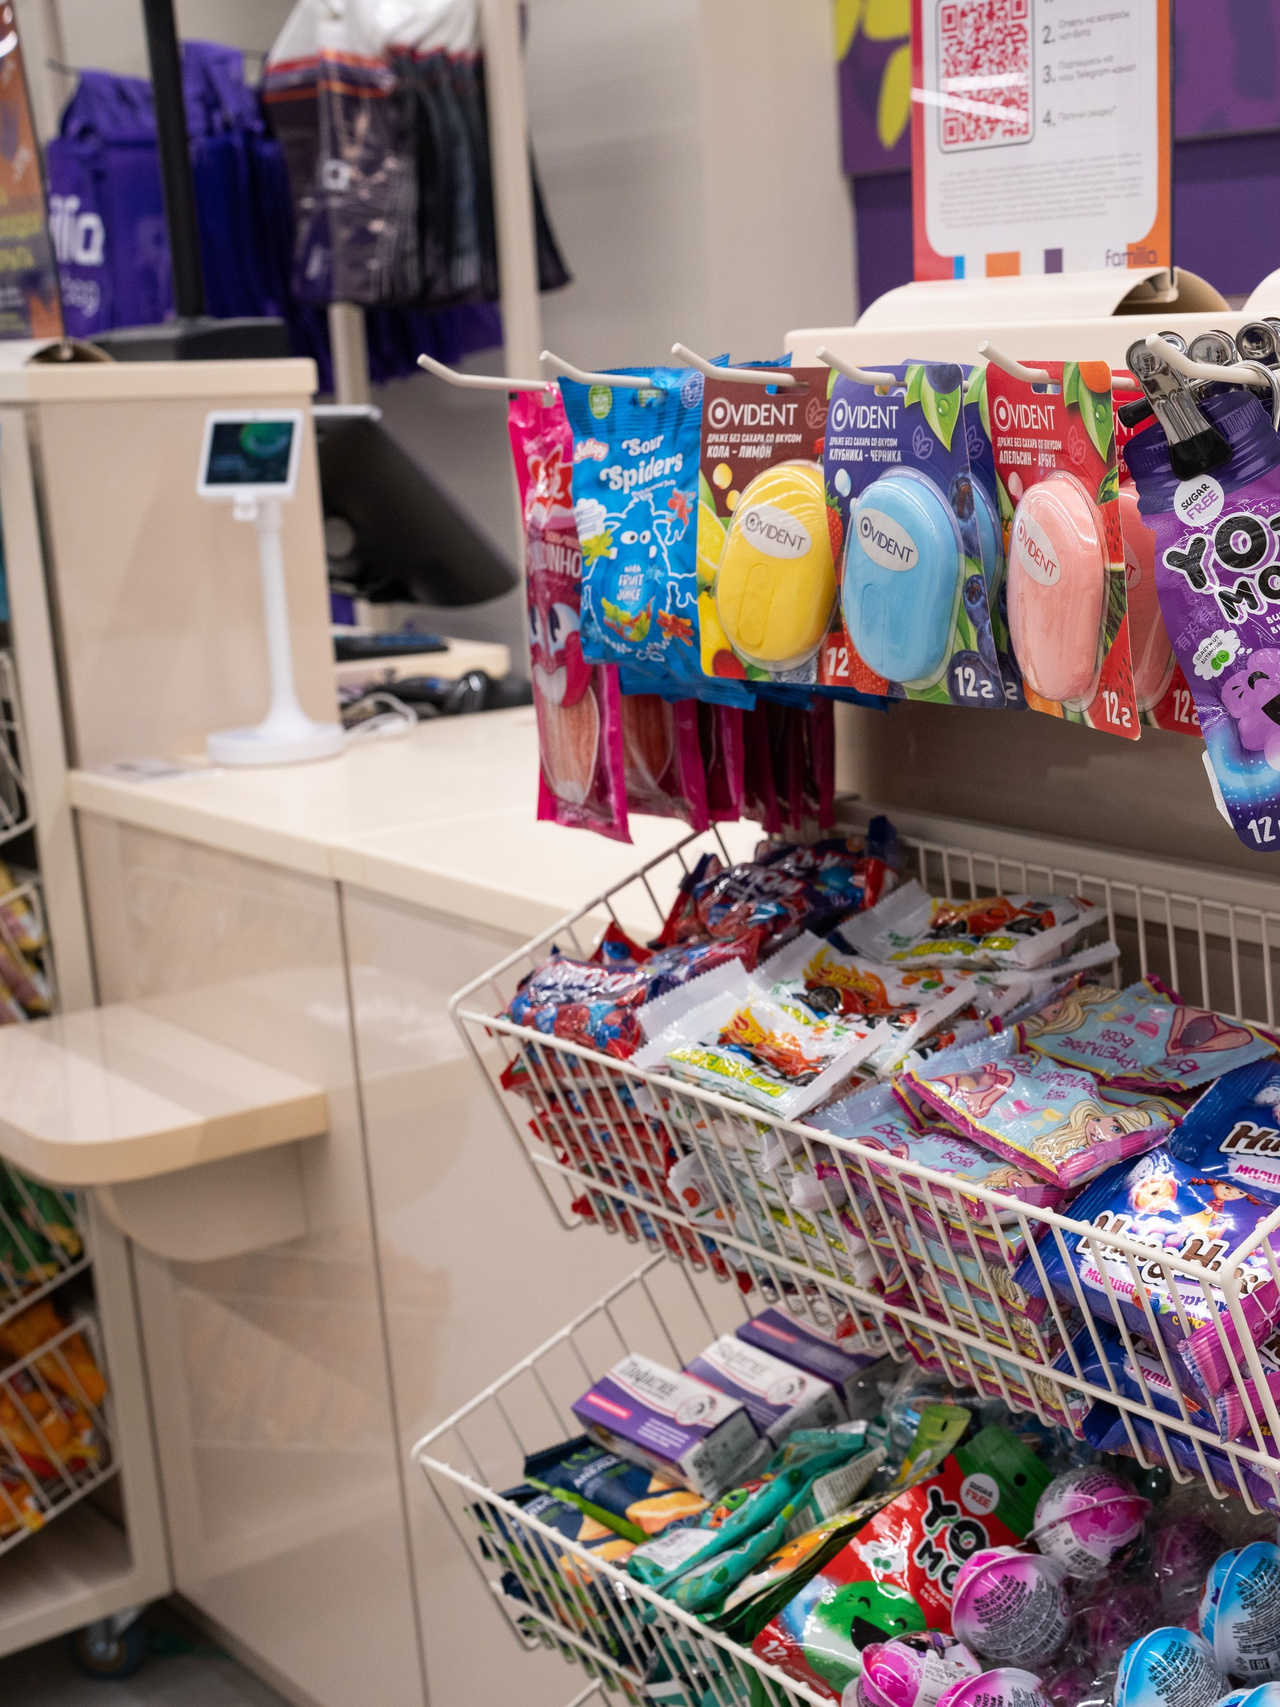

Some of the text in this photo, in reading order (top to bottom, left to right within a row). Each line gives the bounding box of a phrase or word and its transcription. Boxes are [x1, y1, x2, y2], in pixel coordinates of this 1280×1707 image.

[1042, 25, 1055, 44] 2.
[1042, 65, 1056, 84] 3.
[1042, 109, 1056, 127] 4.
[707, 397, 799, 430] OVIDENT
[831, 398, 899, 432] OVIDENT
[993, 396, 1056, 431] OVIDENT
[621, 434, 664, 457] Sour
[706, 433, 802, 443] ДРАЖЕ БЕЗ САХАРА СО ВКУСОМ
[829, 436, 844, 446] ДРАЖЕ
[845, 437, 853, 446] БЕЗ
[853, 437, 871, 446] САХАРА
[878, 438, 898, 447] ВКУСОМ
[997, 437, 1014, 447] ДРАЖЕ
[1014, 438, 1023, 447] БЕЗ
[1023, 438, 1038, 448] САХАРА
[1044, 440, 1062, 450] ВКУСОМ
[706, 445, 773, 459] КОЛА ЛИМОН
[829, 448, 902, 463] КЛУБНИКА ЧЕРНИКА
[999, 450, 1057, 469] АПЕЛЬСИН АРБУЗ
[599, 453, 683, 495] Spiders
[1180, 483, 1211, 511] SUGAR
[1186, 489, 1219, 521] FREE
[745, 511, 806, 551] OVIDENT
[860, 516, 914, 563] OVIDENT
[1017, 518, 1057, 578] OVIDENT
[618, 574, 645, 586] FRUIT
[616, 588, 642, 601] JUICE
[1247, 816, 1276, 844] 12
[941, 1151, 979, 1168] БОБЫ
[965, 1488, 992, 1509] FREE
[968, 1480, 994, 1499] SUGAR
[760, 1639, 788, 1661] 12
